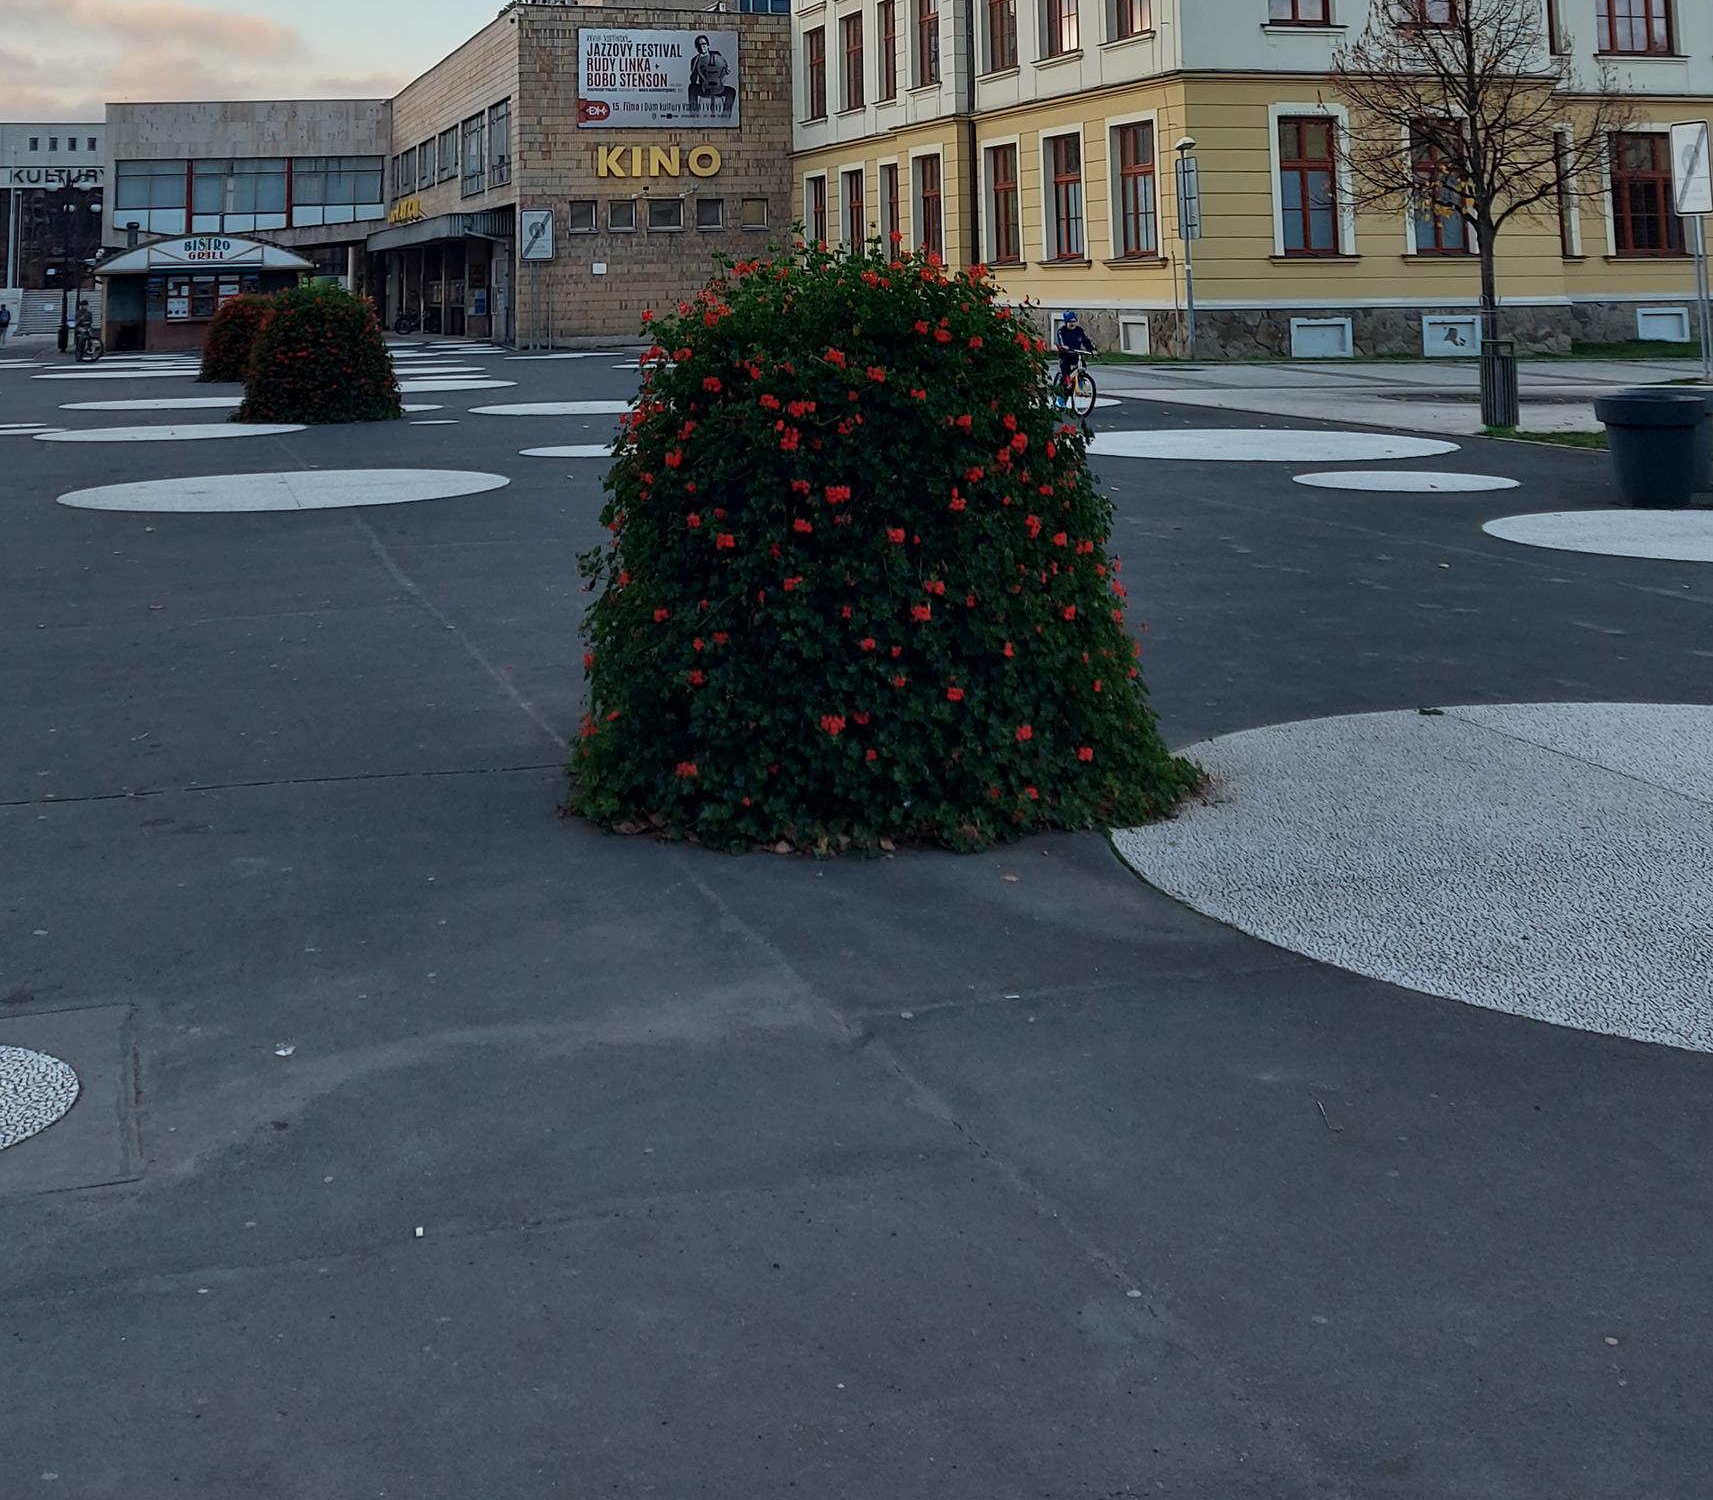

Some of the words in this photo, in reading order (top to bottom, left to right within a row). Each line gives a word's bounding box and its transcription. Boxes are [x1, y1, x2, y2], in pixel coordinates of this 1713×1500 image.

[587, 40, 633, 58] JAZZOVÝ
[636, 43, 683, 58] FESTIVAL
[587, 58, 615, 72] RUDY
[619, 58, 651, 72] LINKA
[587, 72, 616, 87] BOBO
[619, 73, 668, 88] STENSON
[597, 145, 722, 178] KINO
[183, 237, 231, 252] BISTRO
[188, 251, 225, 260] GRILL
